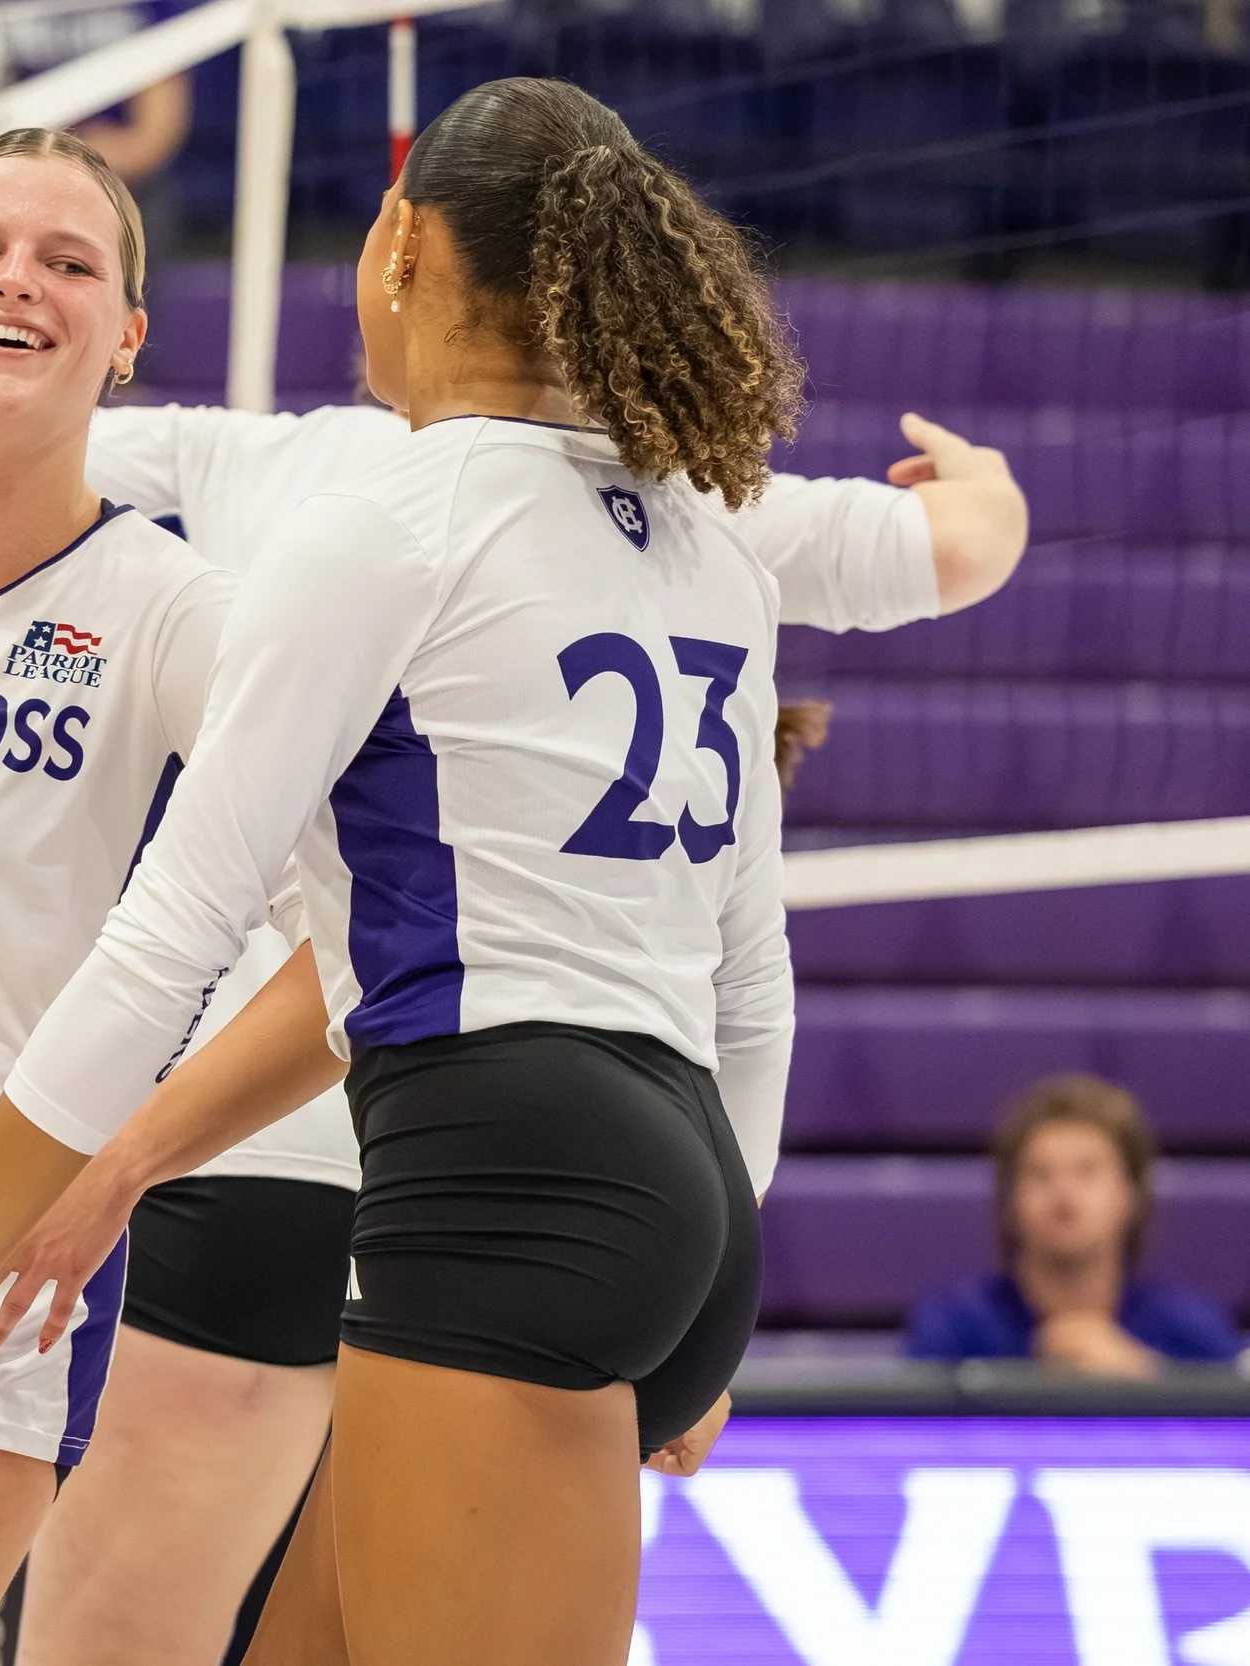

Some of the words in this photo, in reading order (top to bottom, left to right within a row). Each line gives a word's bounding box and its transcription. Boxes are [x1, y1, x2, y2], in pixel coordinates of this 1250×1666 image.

[7, 644, 108, 672] PATRIOT
[3, 659, 102, 688] LEAGUE
[556, 632, 749, 864] 23
